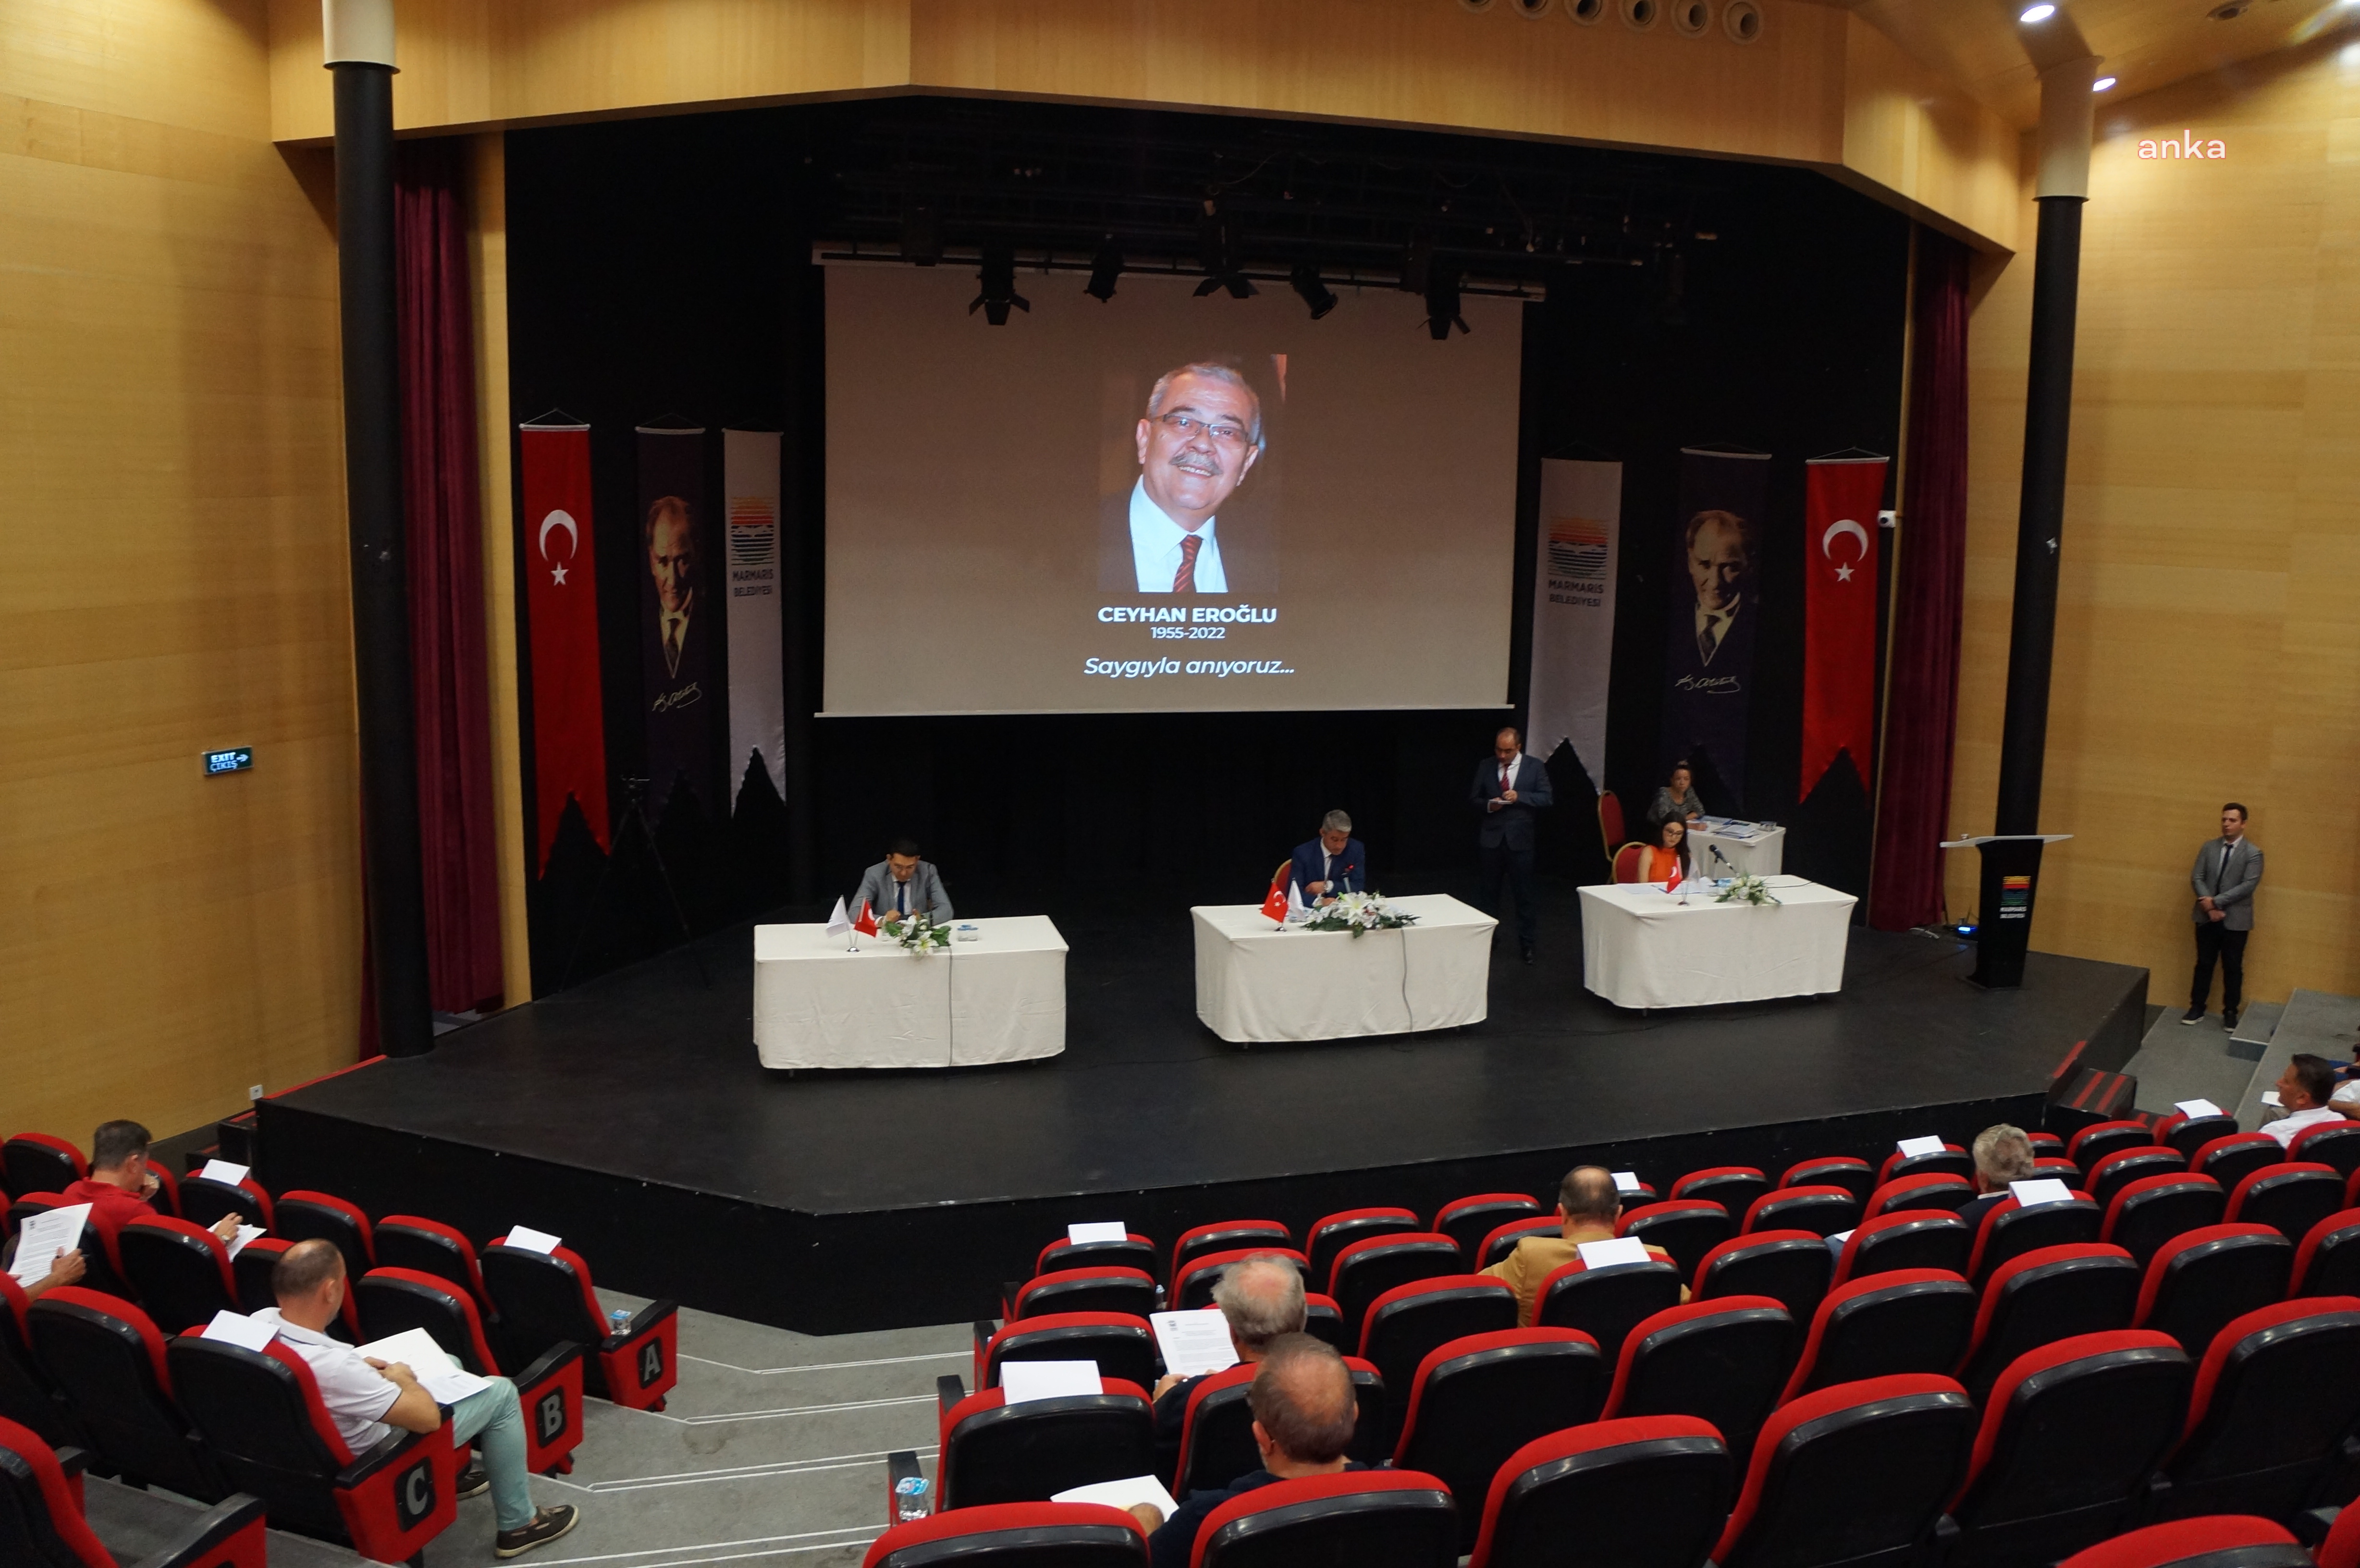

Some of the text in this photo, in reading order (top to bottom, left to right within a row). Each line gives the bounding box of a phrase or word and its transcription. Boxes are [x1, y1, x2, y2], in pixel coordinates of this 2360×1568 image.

[1098, 604, 1277, 623] CEYHAN EROĞLU
[1150, 626, 1226, 639] 1955-2022
[1083, 656, 1295, 678] Saygıyla anıyoruz...
[211, 752, 236, 763] EXIT
[644, 1344, 661, 1382] A
[542, 1394, 563, 1438] B
[406, 1466, 428, 1515] C
